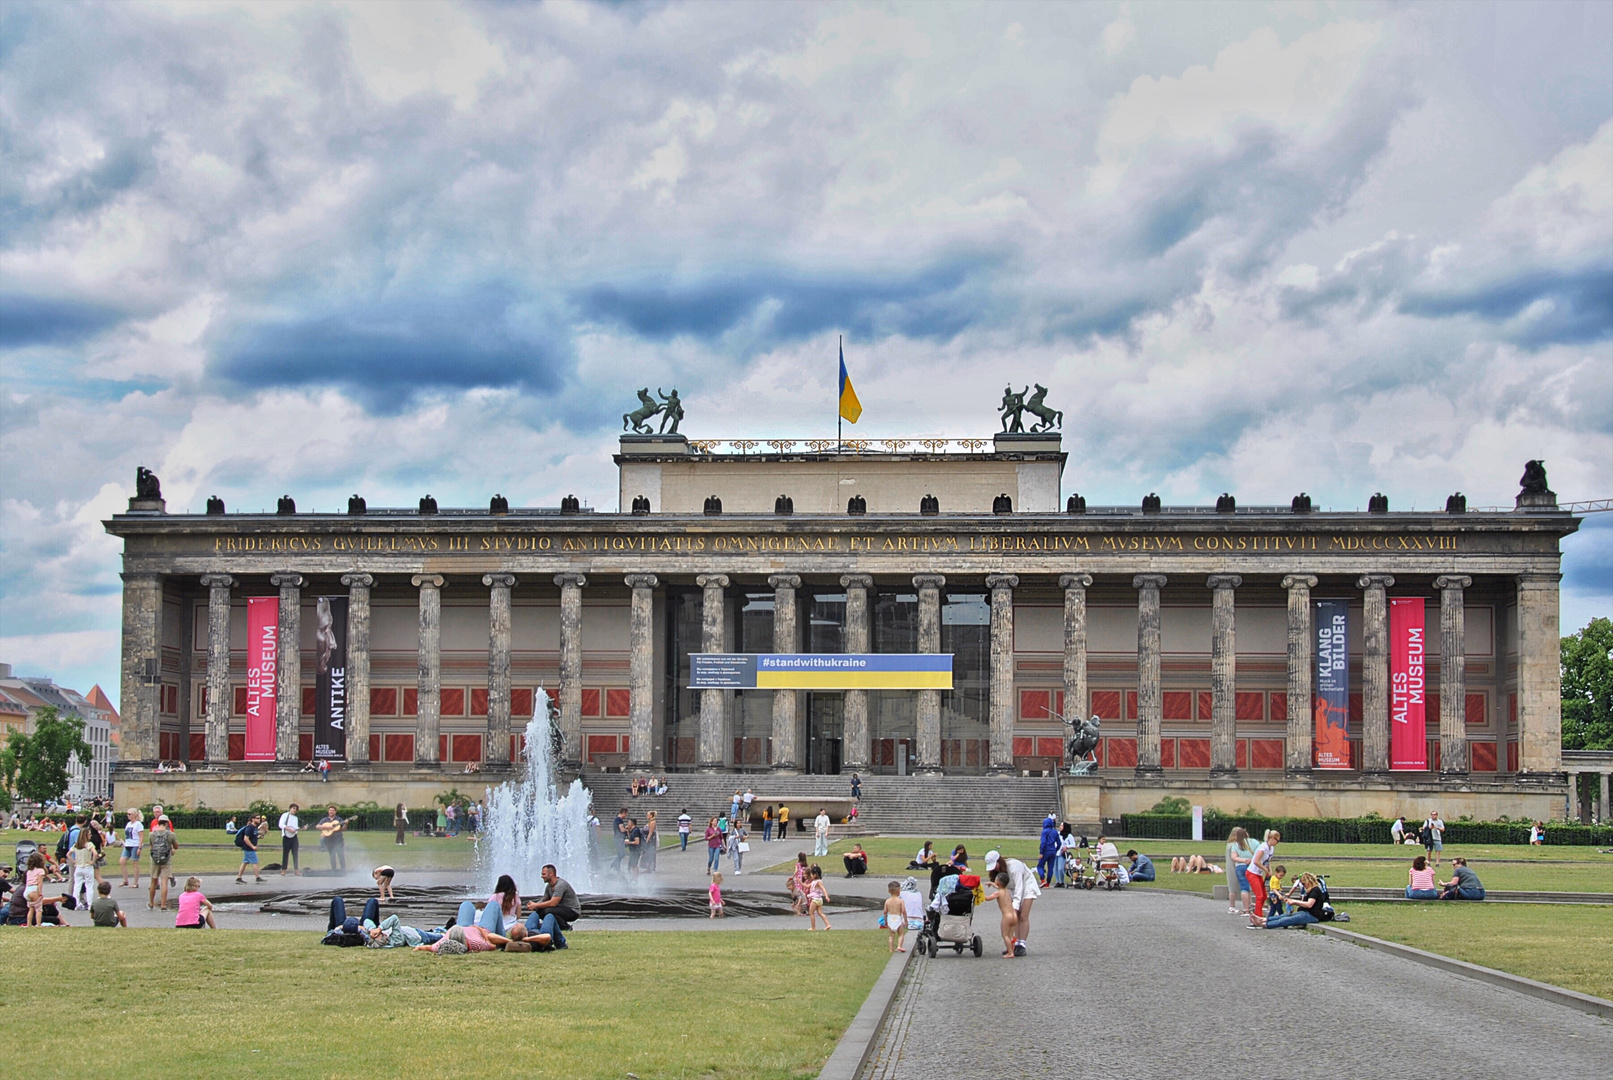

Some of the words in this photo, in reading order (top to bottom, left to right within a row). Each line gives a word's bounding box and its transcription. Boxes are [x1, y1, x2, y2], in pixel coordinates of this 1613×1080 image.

[214, 536, 322, 550] FRIDERICVS
[333, 536, 439, 550] GVILELMVS
[449, 536, 470, 550] III
[480, 536, 551, 550] STVDIO
[562, 536, 706, 550] ANTIQVITATIS
[714, 536, 840, 550] OMNIGENAE
[850, 536, 875, 550] ET
[882, 536, 959, 550] ARTIVM
[969, 536, 1091, 550] LIBERALIVM
[1100, 536, 1184, 550] MVSEVM
[1194, 536, 1319, 550] CONSTITVIT
[1329, 536, 1457, 550] MDCCCXXVIII
[262, 625, 276, 698] MUSEUM
[762, 658, 867, 667] #standwithukraine
[1319, 628, 1332, 678] KLANG
[1332, 615, 1346, 670] BILDER
[1408, 628, 1423, 704] MUSEUM
[248, 667, 260, 717] ALTES
[330, 667, 344, 730] ANTIKE
[1393, 672, 1407, 724] ALTES
